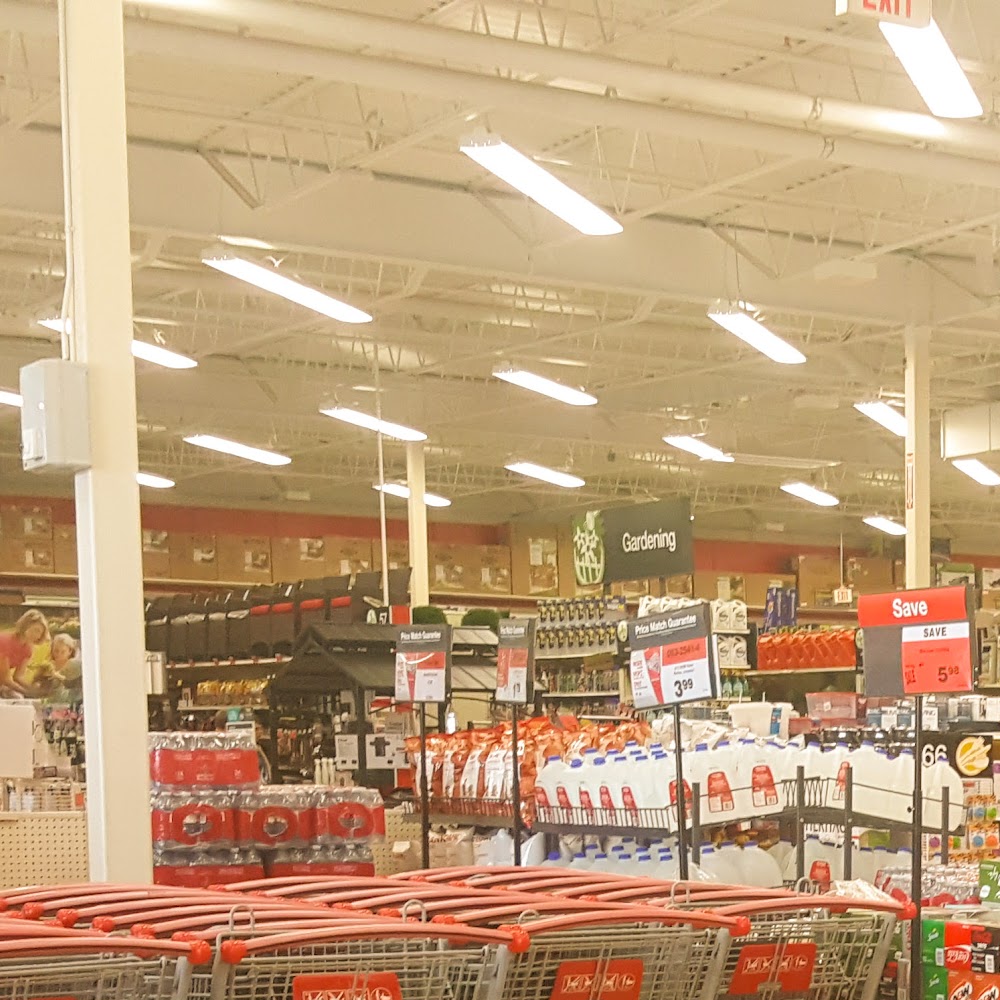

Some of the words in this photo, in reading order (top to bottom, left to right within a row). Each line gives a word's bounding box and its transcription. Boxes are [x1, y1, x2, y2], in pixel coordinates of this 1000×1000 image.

[622, 528, 677, 553] Gardening
[892, 598, 928, 618] Save
[634, 624, 650, 636] Price
[649, 619, 668, 631] Match
[667, 614, 697, 629] Guarantee
[923, 627, 947, 638] SAVE
